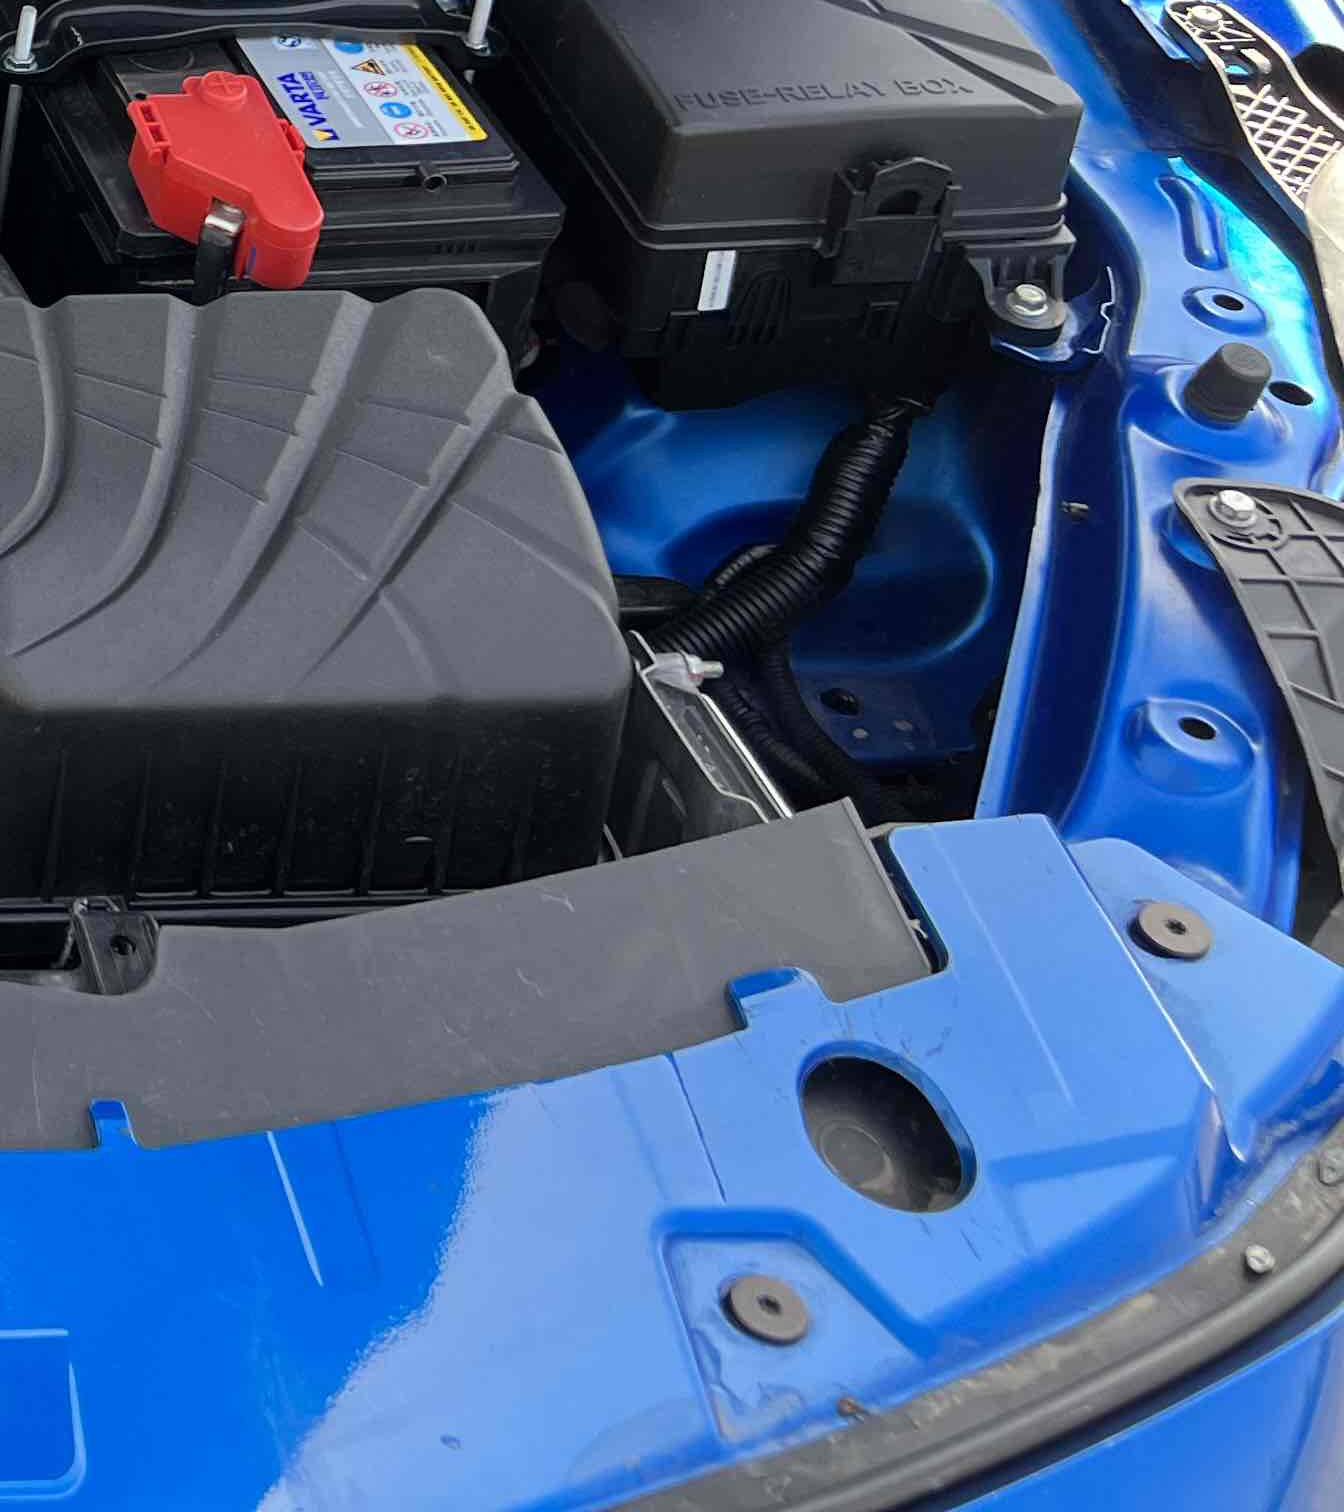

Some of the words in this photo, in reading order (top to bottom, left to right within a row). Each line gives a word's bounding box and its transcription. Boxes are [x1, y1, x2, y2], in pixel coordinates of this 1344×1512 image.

[276, 72, 327, 126] VARTA
[672, 80, 887, 112] FUSE-RELAY
[893, 77, 975, 96] BOX
